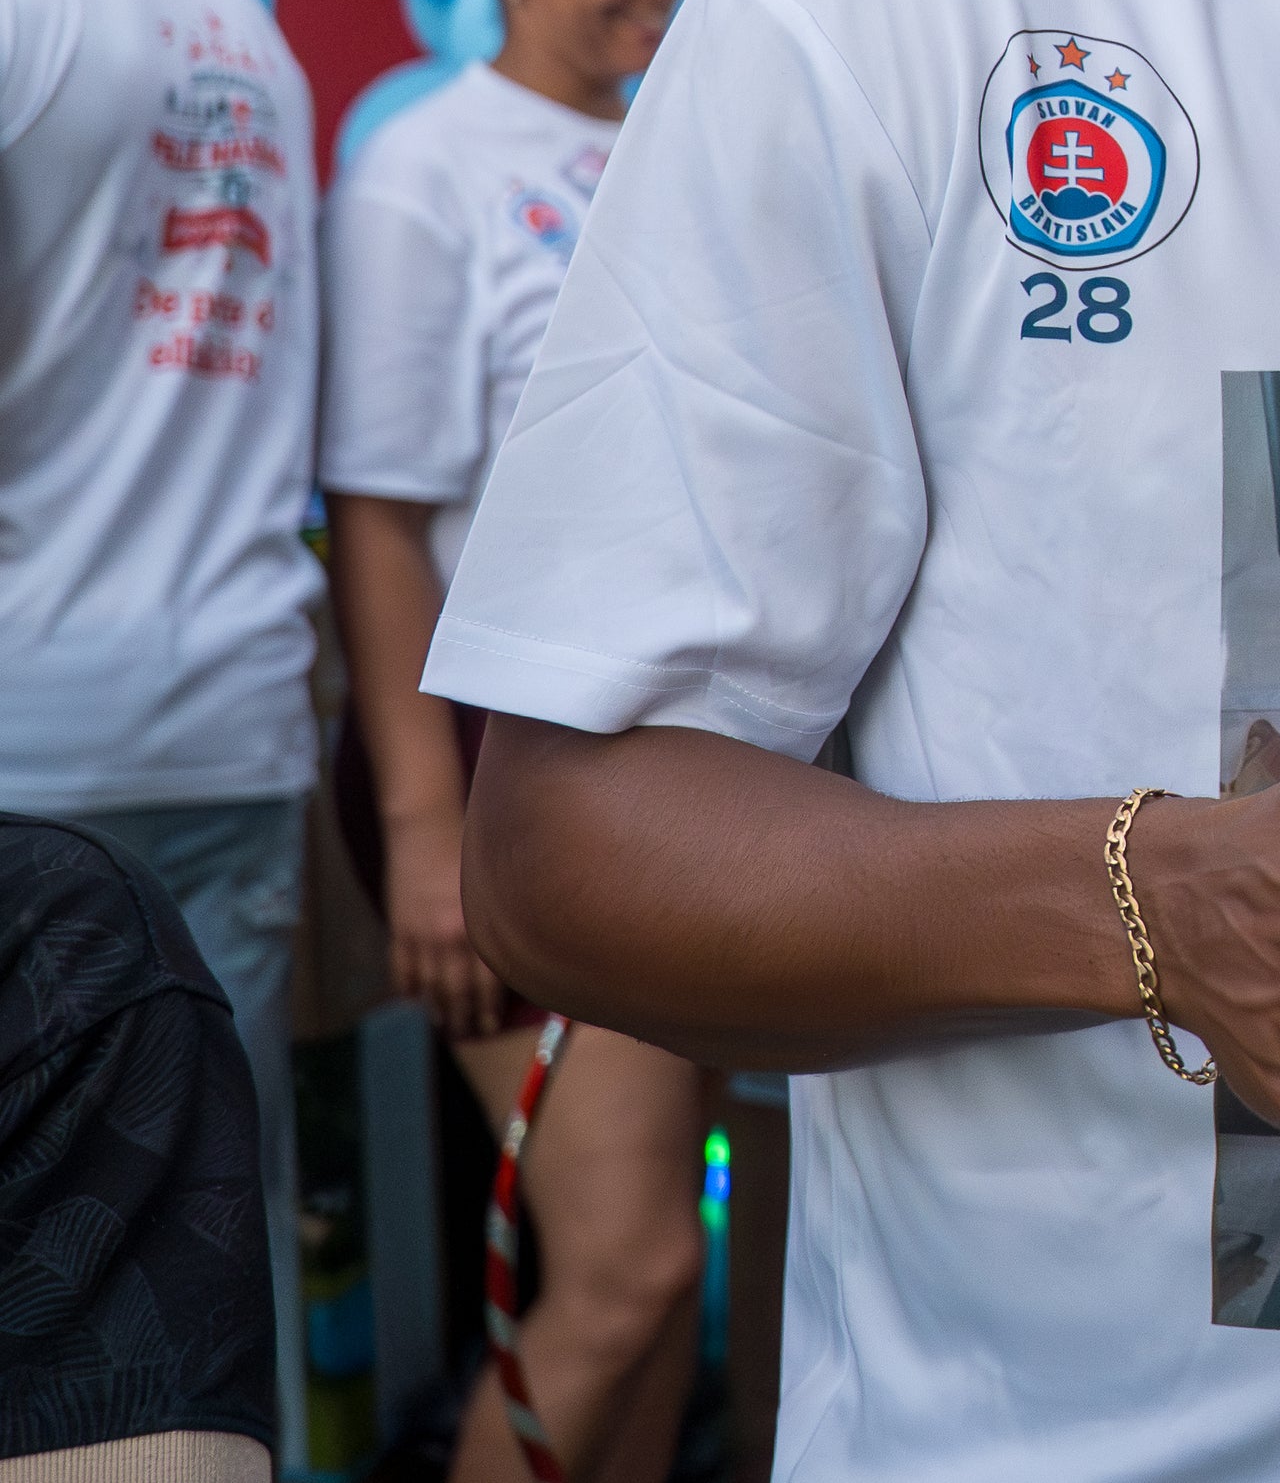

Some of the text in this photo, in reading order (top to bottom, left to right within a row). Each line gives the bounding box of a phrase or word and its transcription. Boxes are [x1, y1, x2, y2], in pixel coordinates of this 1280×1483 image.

[1036, 98, 1116, 129] SLOVAN
[1018, 193, 1138, 243] BRATISLAVA
[1020, 272, 1132, 344] 28
